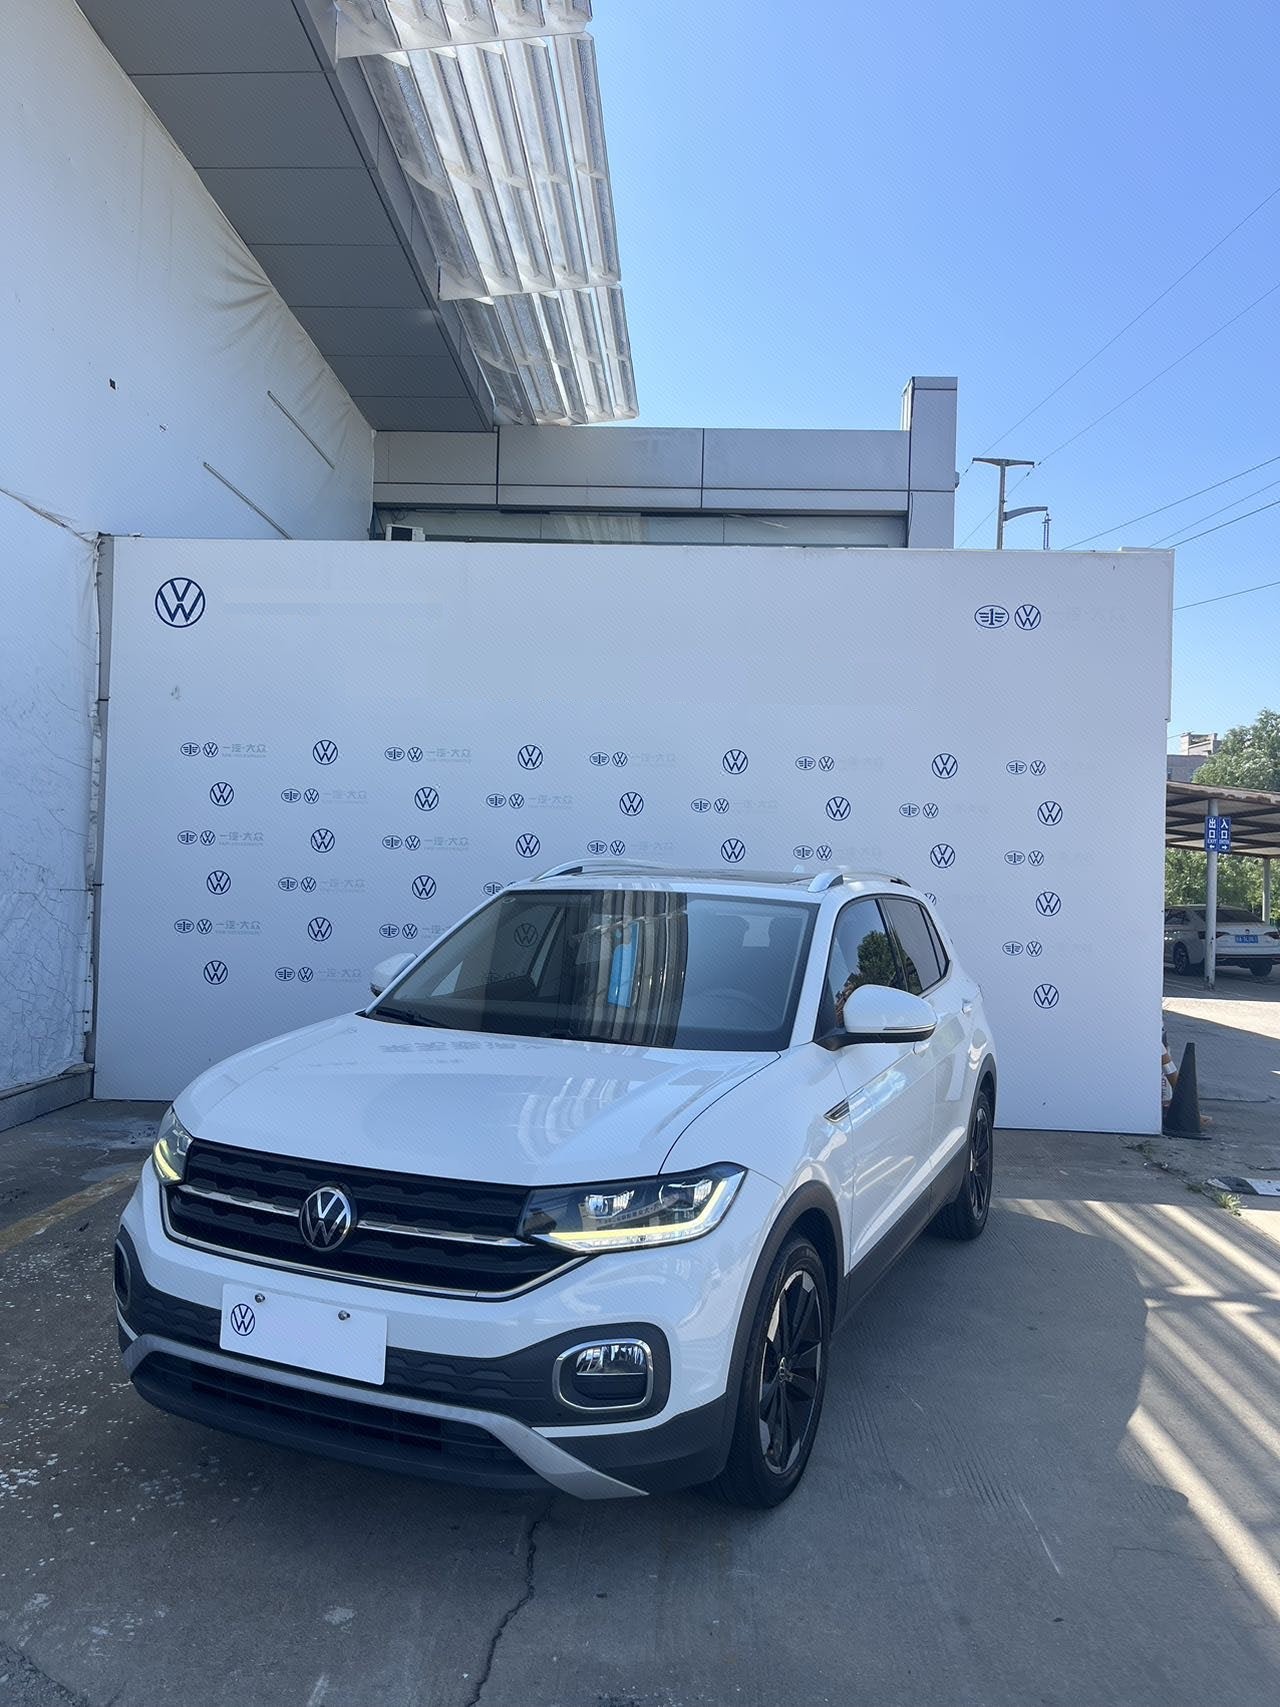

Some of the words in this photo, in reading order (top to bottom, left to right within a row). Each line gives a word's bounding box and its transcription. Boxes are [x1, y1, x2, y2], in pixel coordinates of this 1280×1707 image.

[1208, 817, 1216, 839] 出口
[1220, 818, 1229, 839] 入口
[300, 1186, 351, 1251] VW
